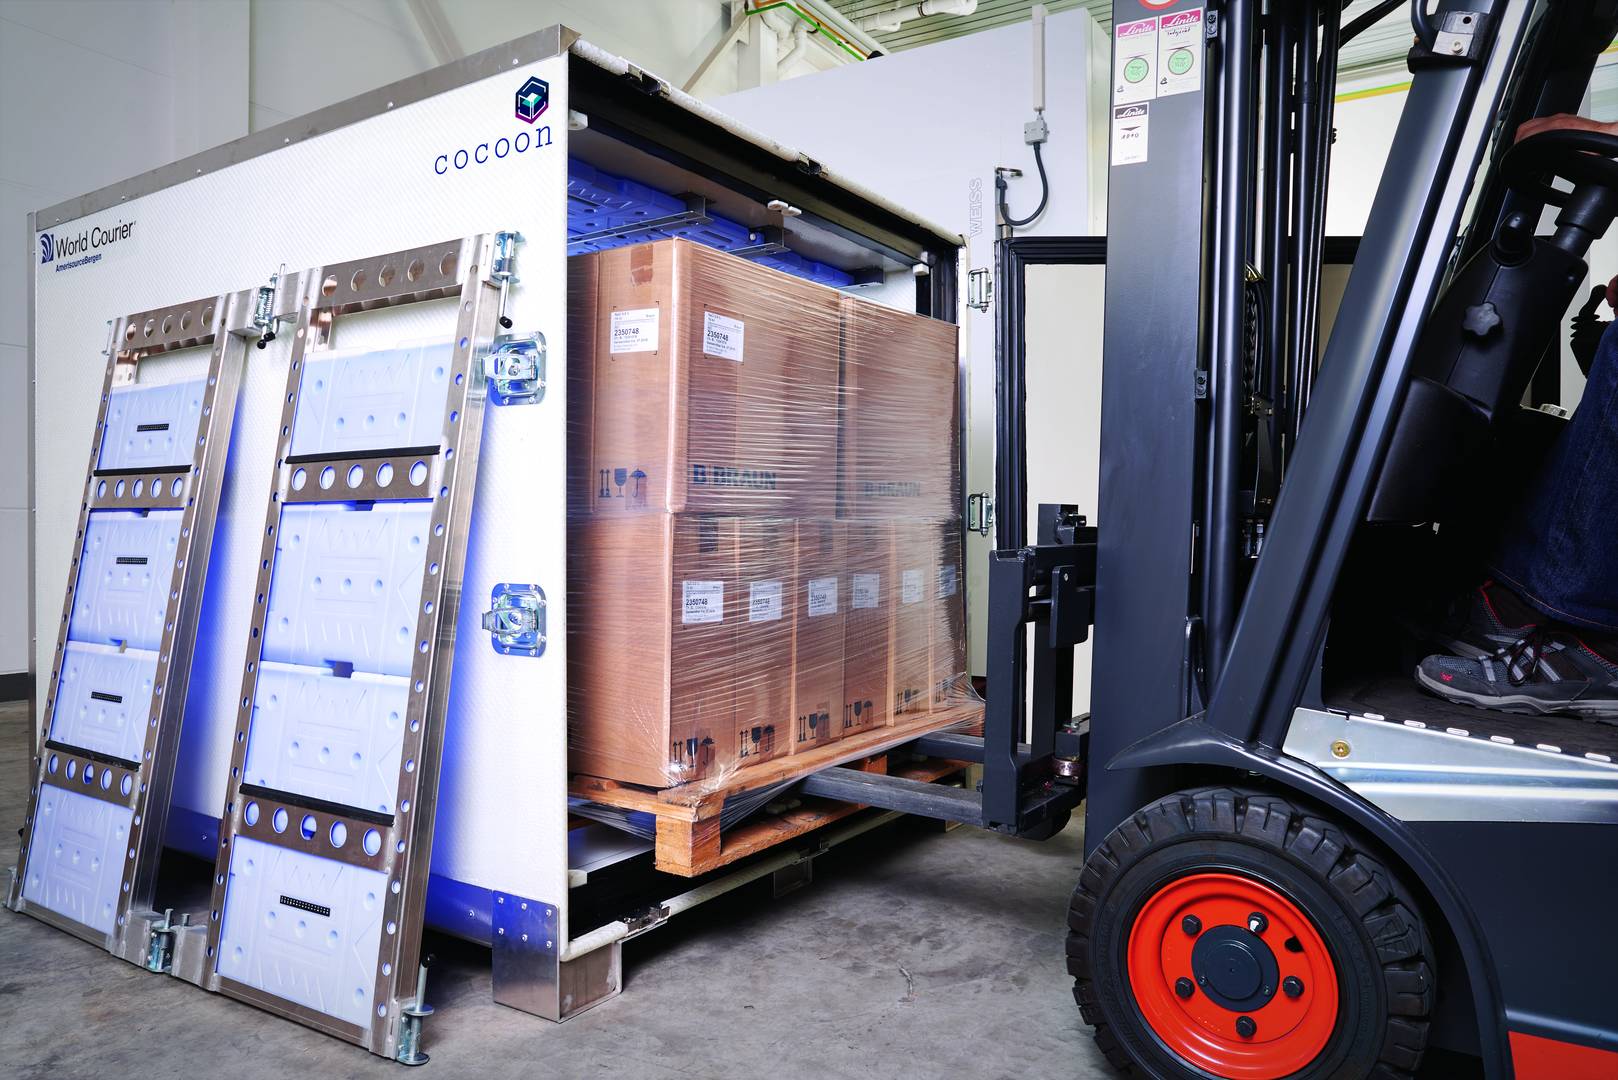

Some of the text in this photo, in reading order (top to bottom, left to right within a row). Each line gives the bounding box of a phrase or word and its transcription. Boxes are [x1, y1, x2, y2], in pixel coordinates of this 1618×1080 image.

[1163, 13, 1199, 28] Linde
[1119, 22, 1154, 37] Linde
[1117, 107, 1145, 119] Linde
[434, 125, 553, 175] cocoon
[969, 177, 983, 239] WEISS
[55, 219, 134, 259] World Courier
[55, 253, 102, 273] AmerisourceBergen
[614, 327, 640, 337] 2350748
[707, 329, 729, 341] 2350748
[685, 598, 708, 606] 2350748
